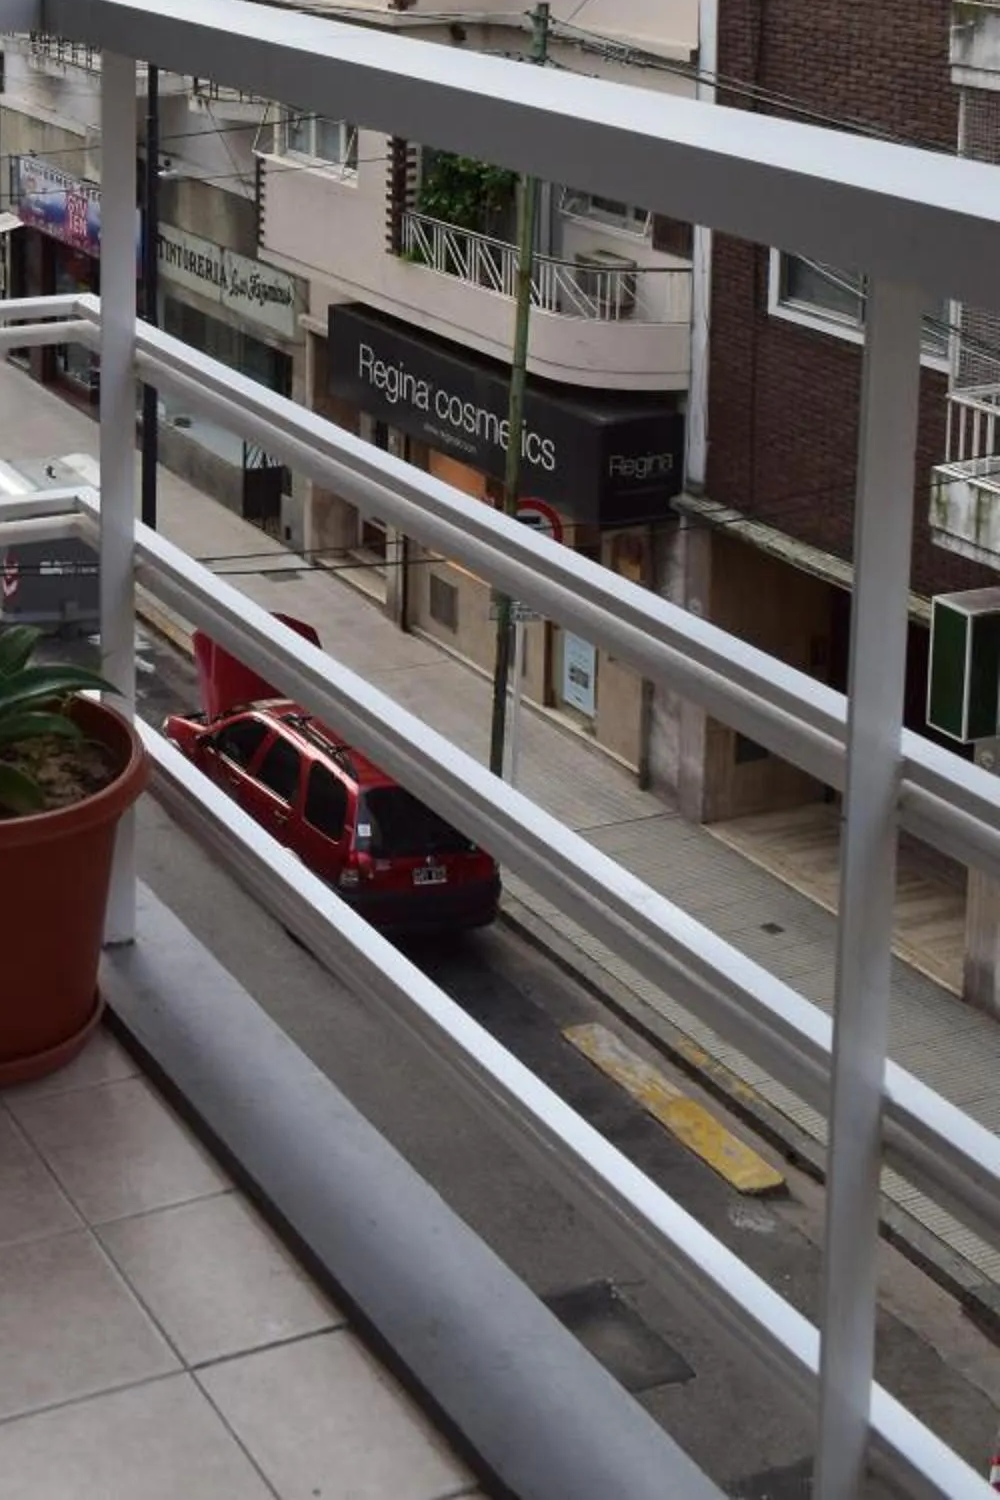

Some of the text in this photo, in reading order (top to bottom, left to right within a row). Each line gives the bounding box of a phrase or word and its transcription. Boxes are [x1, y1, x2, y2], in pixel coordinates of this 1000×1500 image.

[359, 343, 429, 412] Regina
[435, 390, 555, 471] cosmeics
[609, 451, 673, 479] Regina
